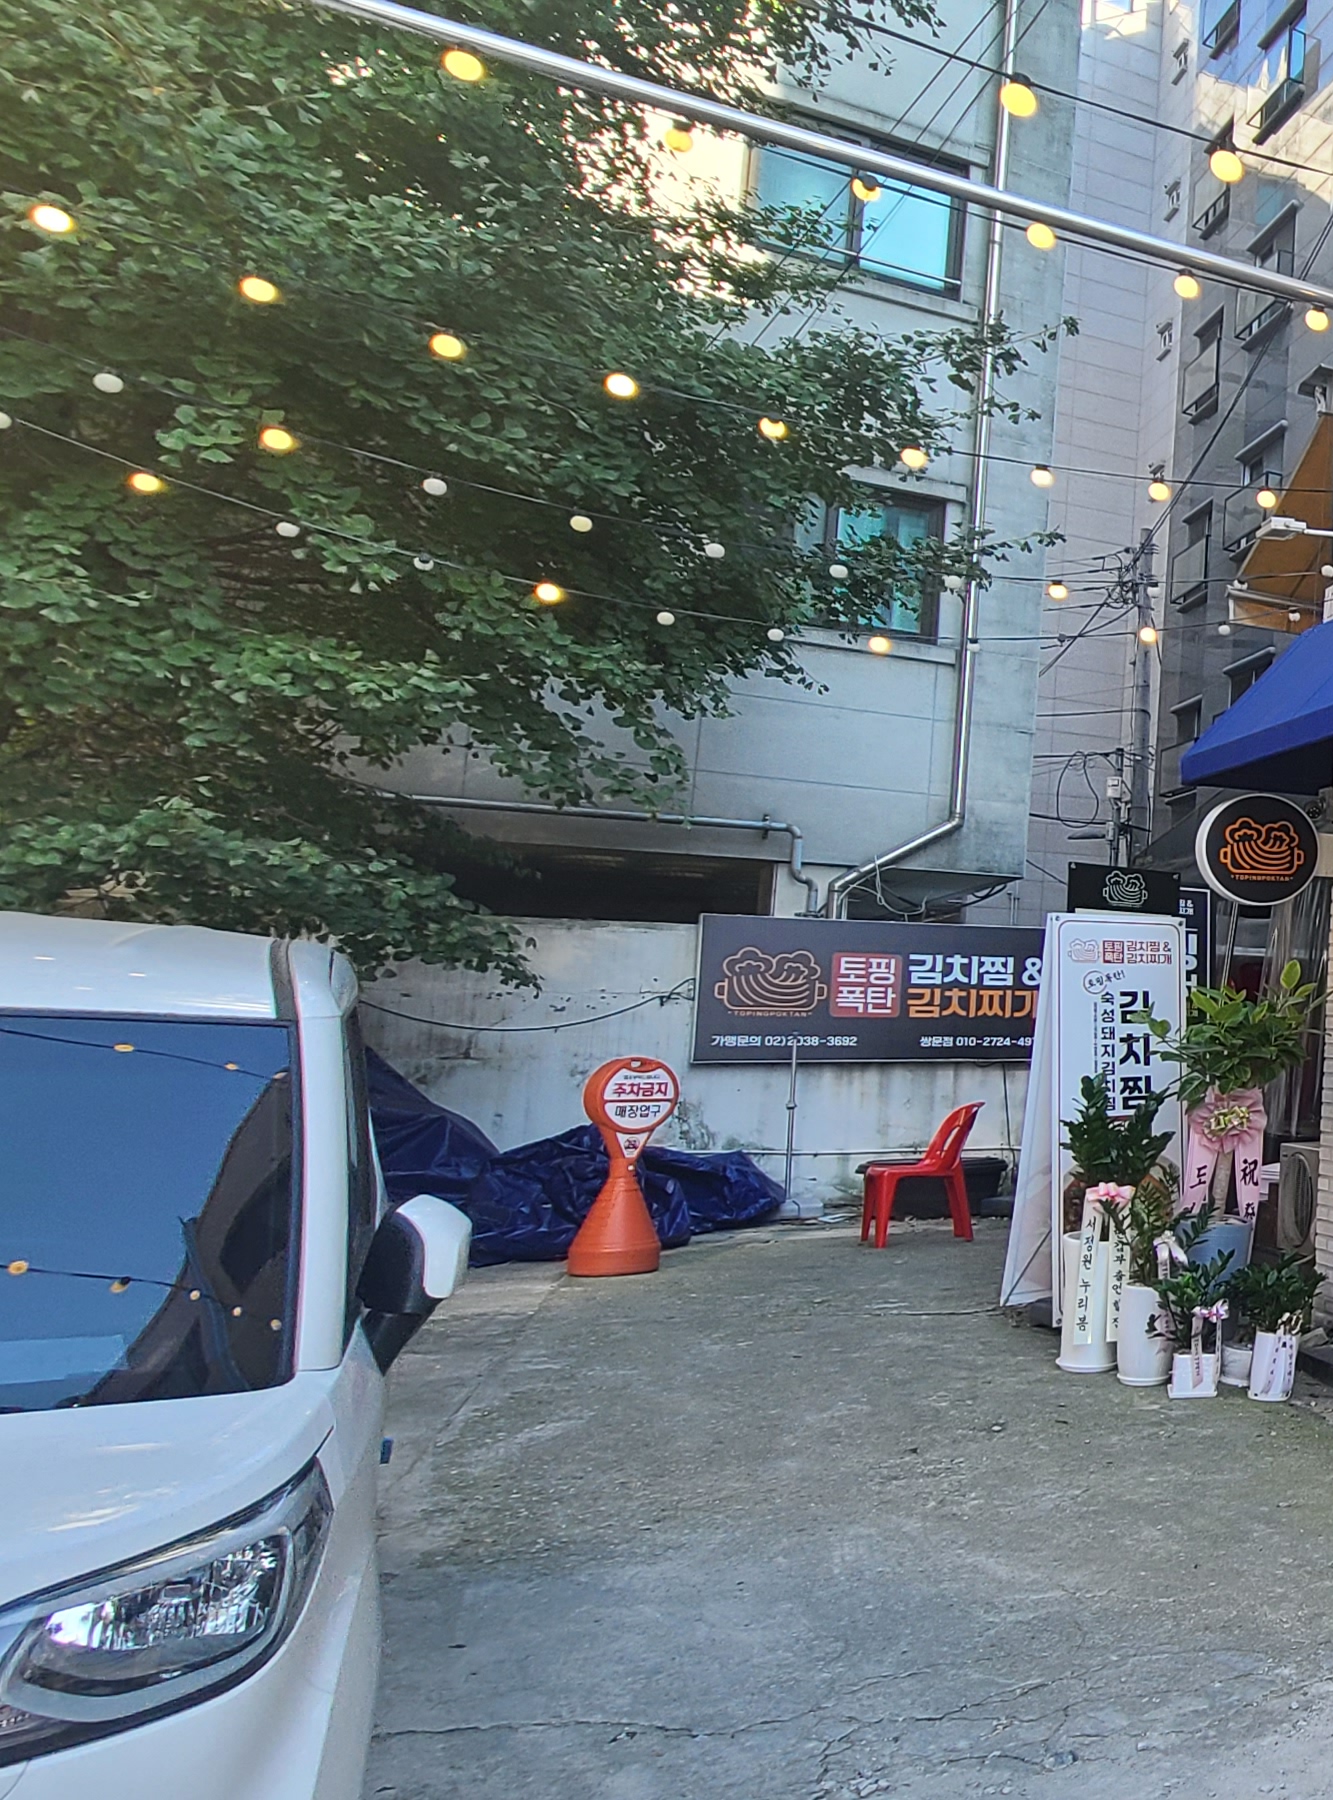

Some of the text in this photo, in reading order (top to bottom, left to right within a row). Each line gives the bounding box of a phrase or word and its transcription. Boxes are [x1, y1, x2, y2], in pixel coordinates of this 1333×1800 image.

[1104, 942, 1123, 951] 토핑
[1127, 941, 1172, 952] 김치찜 &
[1104, 952, 1123, 963] 폭탄
[1127, 954, 1172, 964] 김치찌개
[837, 957, 896, 985] 토핑
[908, 953, 1044, 986] 김치찜 &
[836, 986, 896, 1014] 폭탄
[734, 1010, 806, 1018] TOPINGPOKTAN
[711, 1035, 761, 1047] 가맹문의
[920, 1036, 1034, 1047] 쌍문점 010-2724-49
[1119, 991, 1151, 1110] 김치찜
[612, 1082, 668, 1097] 주차금지
[615, 1105, 661, 1118] 매장입구
[1240, 1158, 1259, 1186] 祝
[1075, 1217, 1097, 1332] 서정원 누리봄
